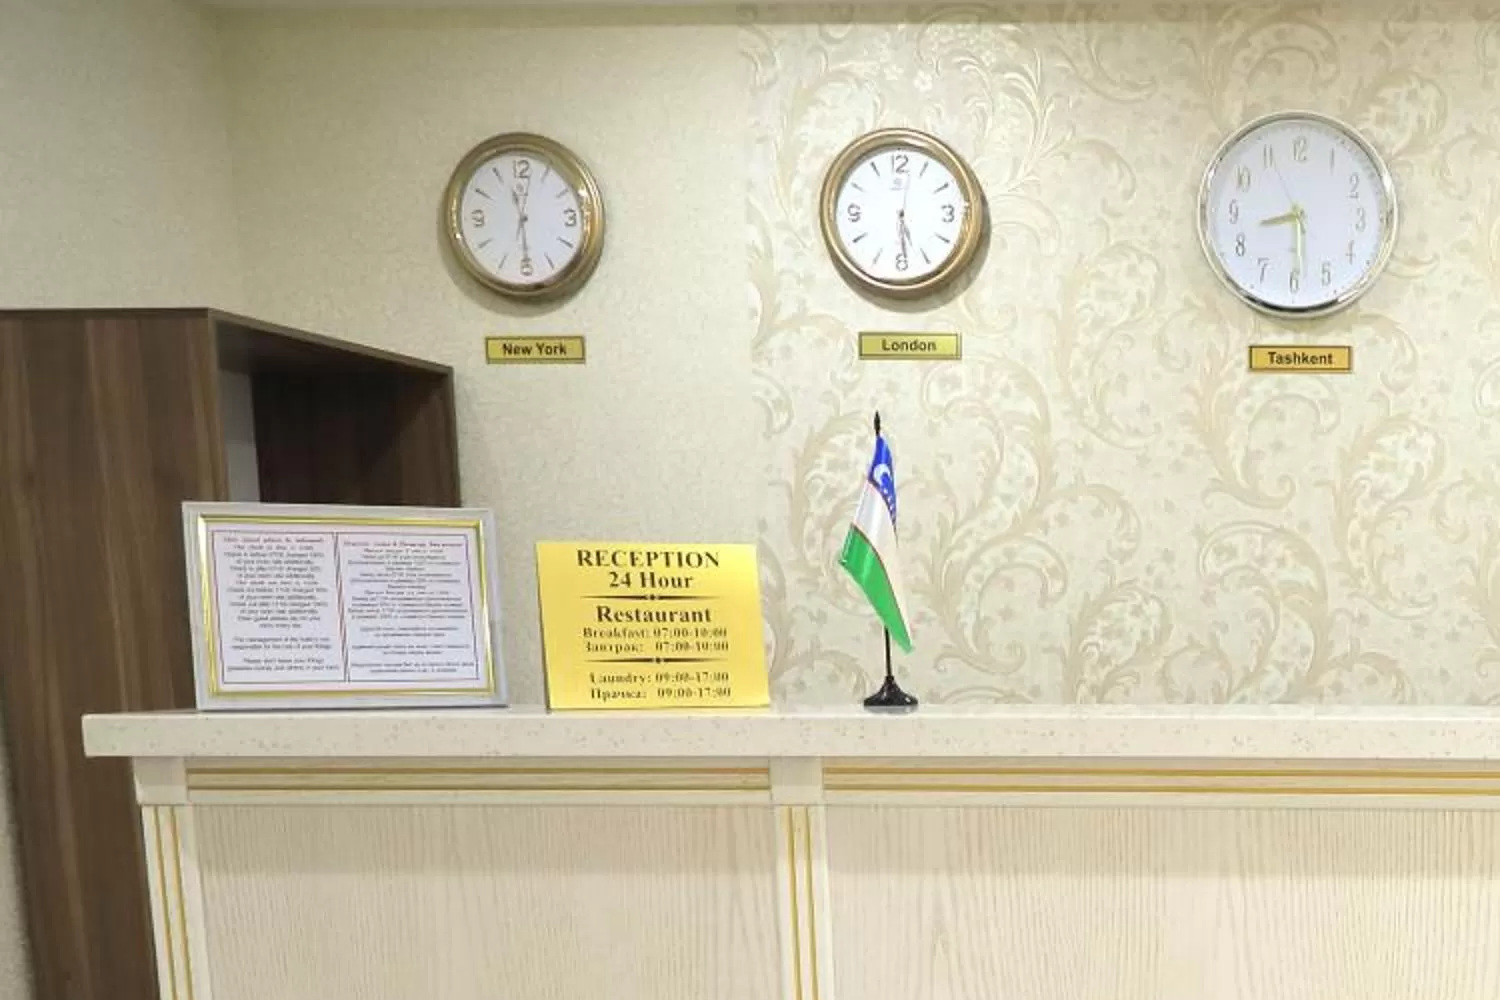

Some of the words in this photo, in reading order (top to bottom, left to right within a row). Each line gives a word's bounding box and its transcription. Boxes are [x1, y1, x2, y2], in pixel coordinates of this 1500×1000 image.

[1263, 144, 1273, 168] 11
[1293, 136, 1308, 162] 12
[513, 160, 530, 178] 12
[891, 155, 909, 173] 12
[1349, 172, 1360, 199] 2
[563, 208, 577, 227] 3
[941, 204, 955, 223] 3
[1229, 199, 1239, 224] 9
[1356, 208, 1366, 232] 3
[1235, 232, 1246, 257] 8
[1257, 257, 1269, 282] 7
[1321, 262, 1331, 286] 5
[1289, 267, 1300, 293] 6
[502, 342, 532, 356] New
[536, 342, 567, 356] York
[881, 338, 937, 352] London
[1267, 351, 1333, 365] Tashkent
[577, 549, 719, 569] RECEPTION
[608, 571, 632, 588] 24
[640, 571, 694, 589] Hour
[596, 605, 712, 623] Restaurant
